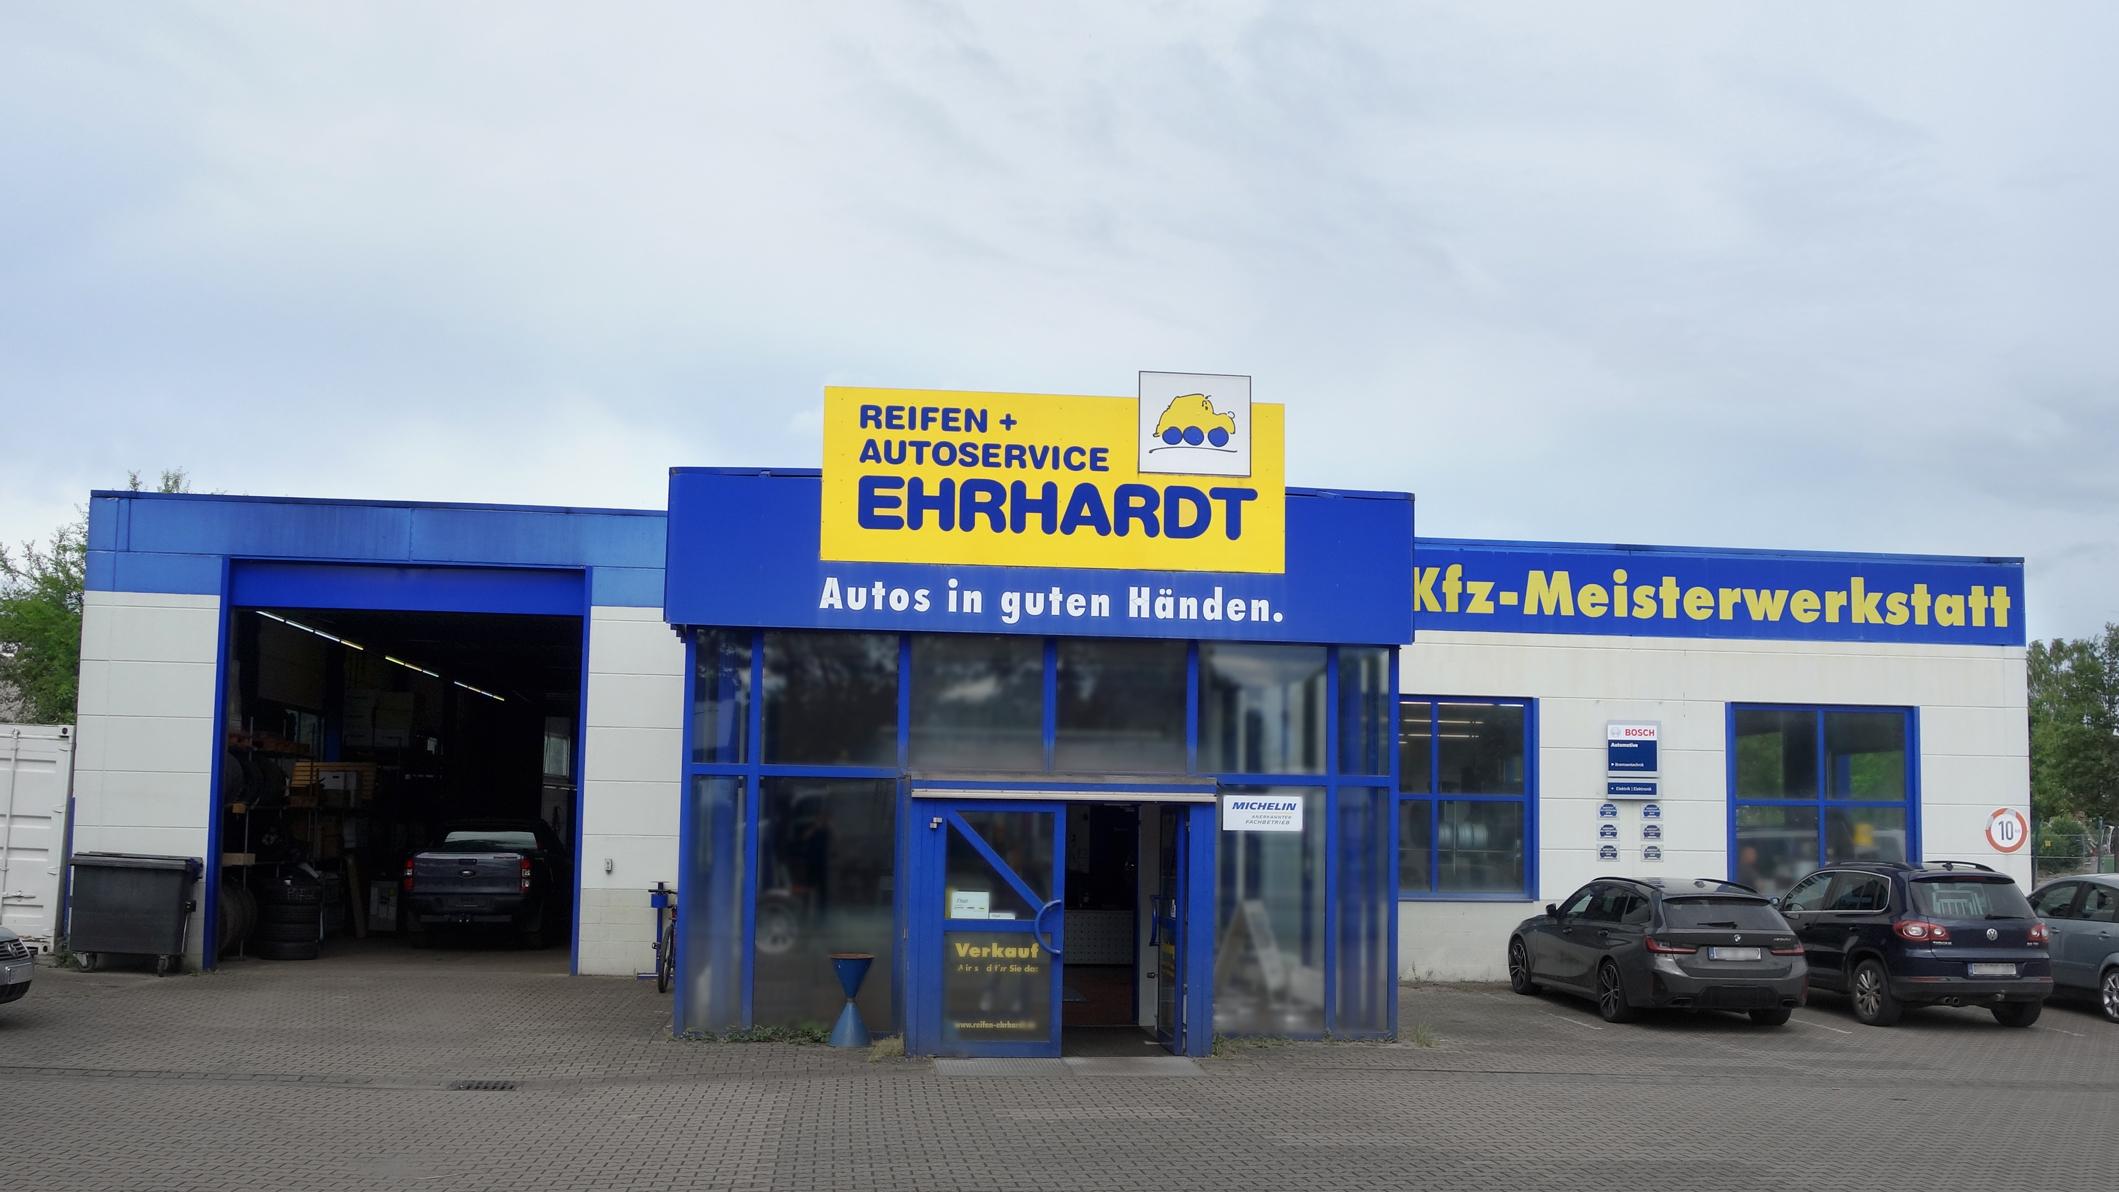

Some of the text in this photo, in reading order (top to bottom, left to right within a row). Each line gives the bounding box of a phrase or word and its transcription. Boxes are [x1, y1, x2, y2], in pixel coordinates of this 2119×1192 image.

[859, 405, 988, 433] REIFEN
[859, 439, 1109, 472] AUTOSERVICE
[857, 475, 1258, 541] EHRHARDT
[818, 576, 1285, 625] Autos in guten Händen.
[1413, 564, 2011, 628] Kfz-Meisterwerkstatt
[1624, 728, 1655, 737] BOSCH
[1231, 801, 1297, 811] MICHELIN
[1998, 820, 2014, 841] 10
[954, 942, 1040, 959] Verkauf
